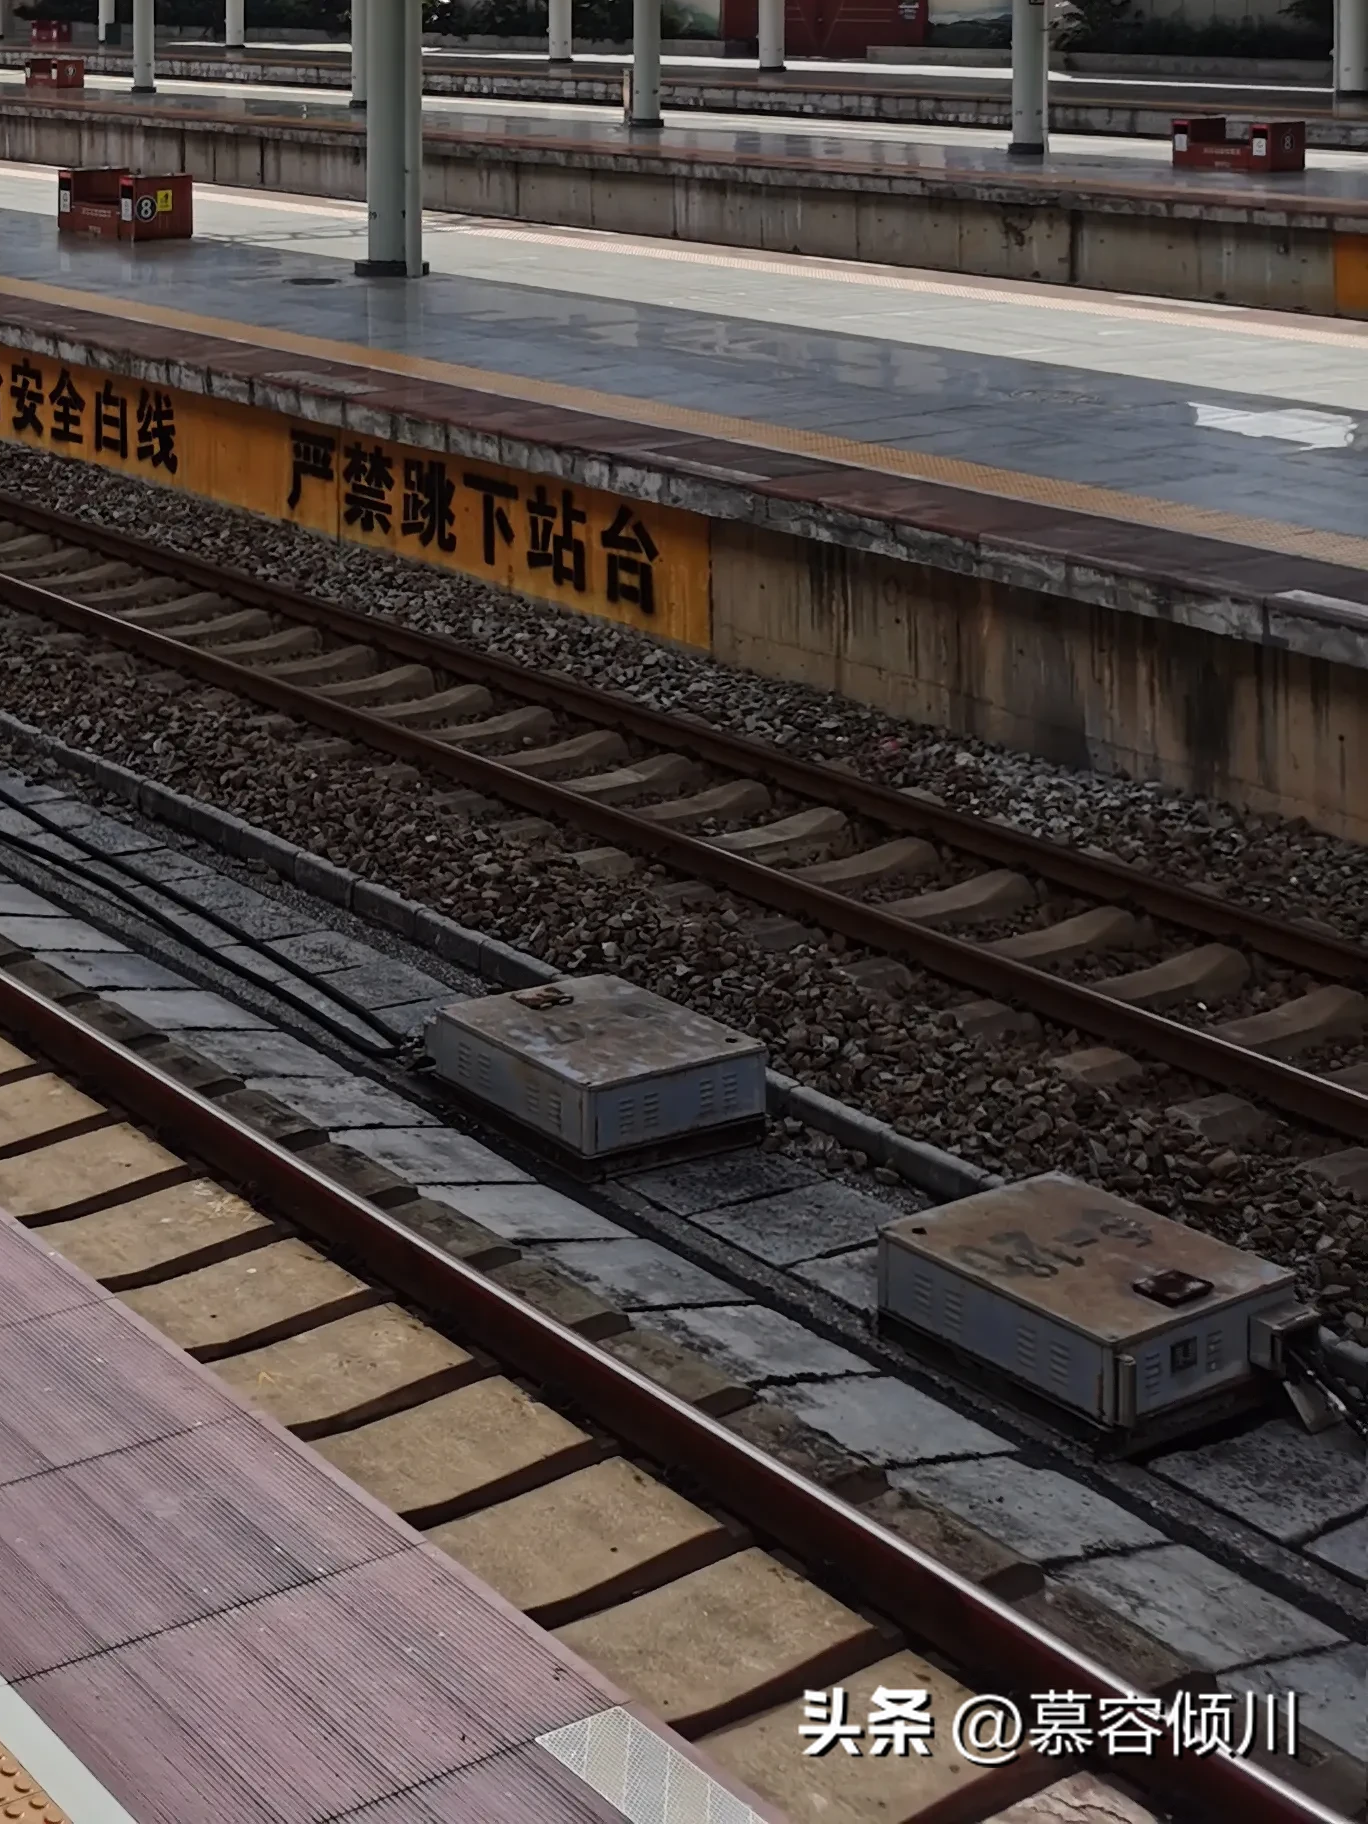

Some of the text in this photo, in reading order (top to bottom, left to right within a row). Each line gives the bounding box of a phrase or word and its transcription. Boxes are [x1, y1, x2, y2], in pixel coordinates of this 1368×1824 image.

[140, 199, 152, 218] 8
[287, 428, 661, 615] 严禁跳下站台
